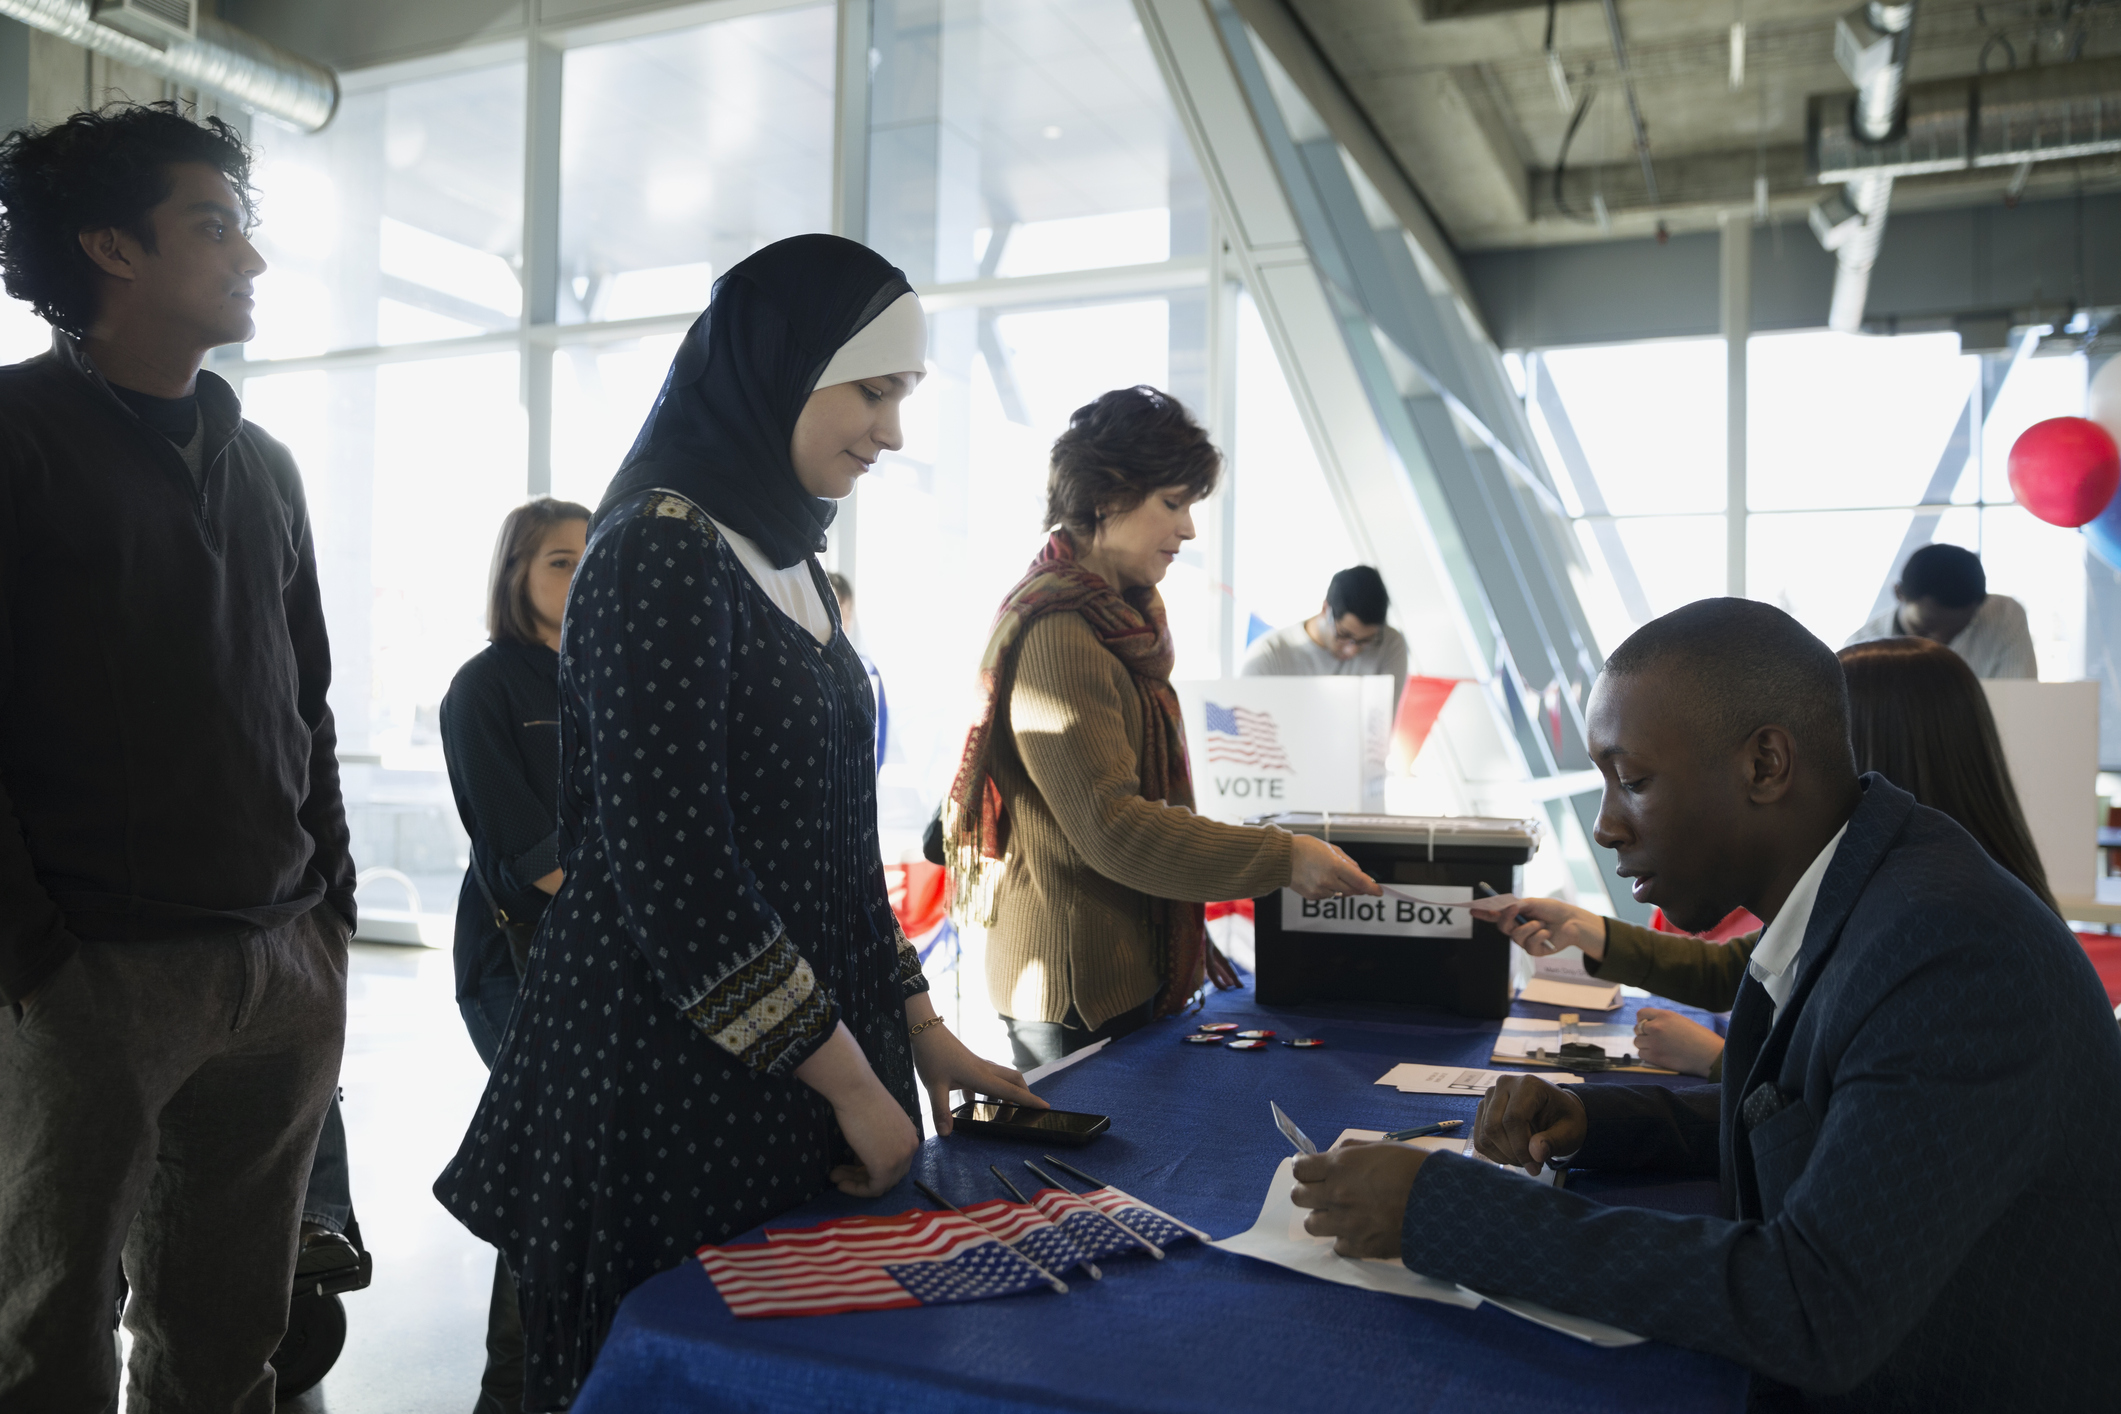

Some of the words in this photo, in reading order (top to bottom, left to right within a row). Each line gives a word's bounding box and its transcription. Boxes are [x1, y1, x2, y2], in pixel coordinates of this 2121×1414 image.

[1214, 776, 1285, 799] VOTE
[1302, 897, 1386, 922] Ballot
[1396, 899, 1453, 925] Box
